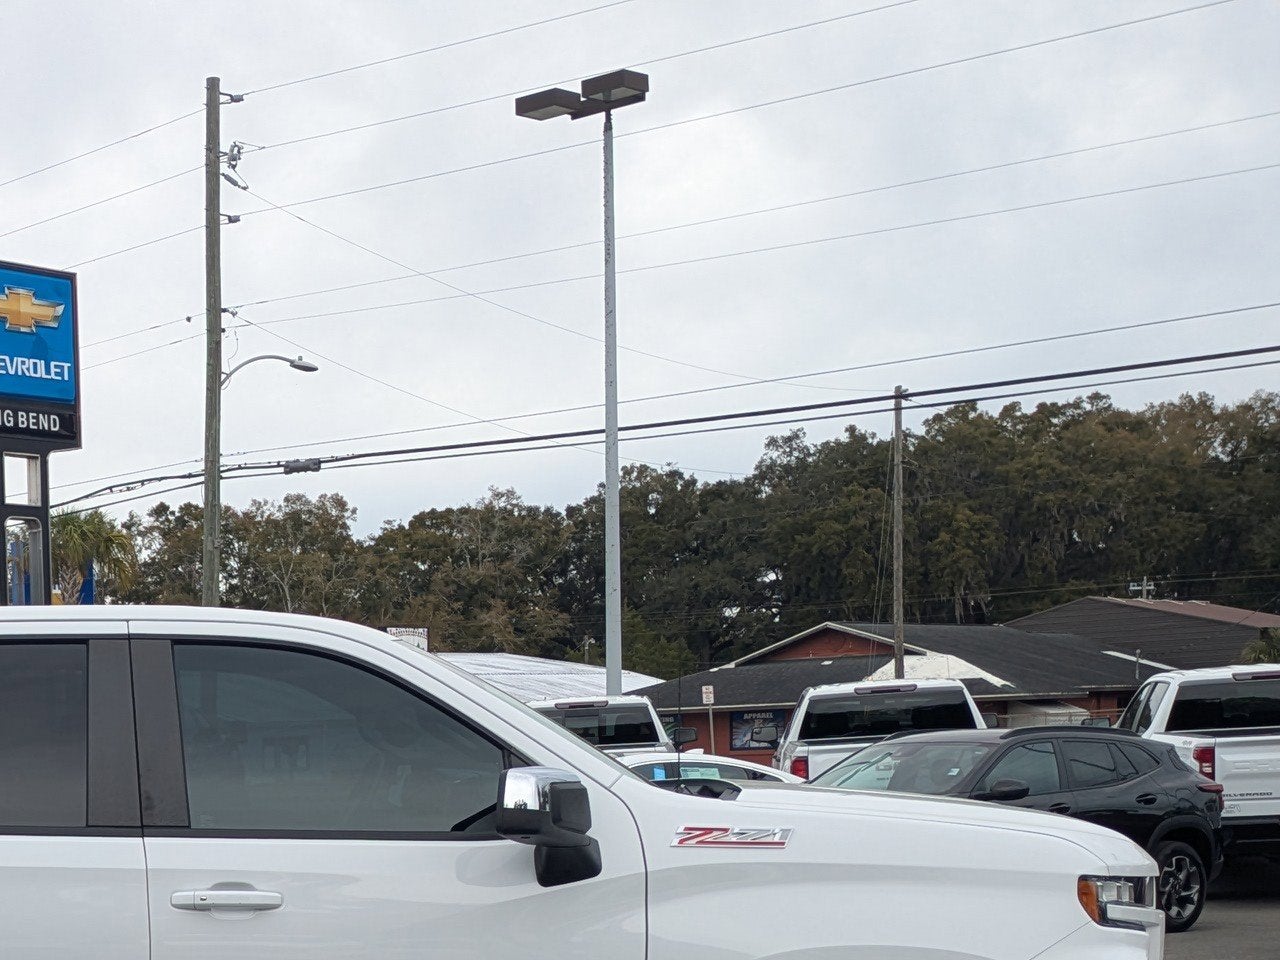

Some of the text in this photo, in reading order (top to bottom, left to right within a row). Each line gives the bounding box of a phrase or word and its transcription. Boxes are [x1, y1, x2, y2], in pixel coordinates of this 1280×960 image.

[18, 410, 60, 432] BEND
[743, 712, 774, 720] APPAREL
[670, 825, 794, 849] Z71
